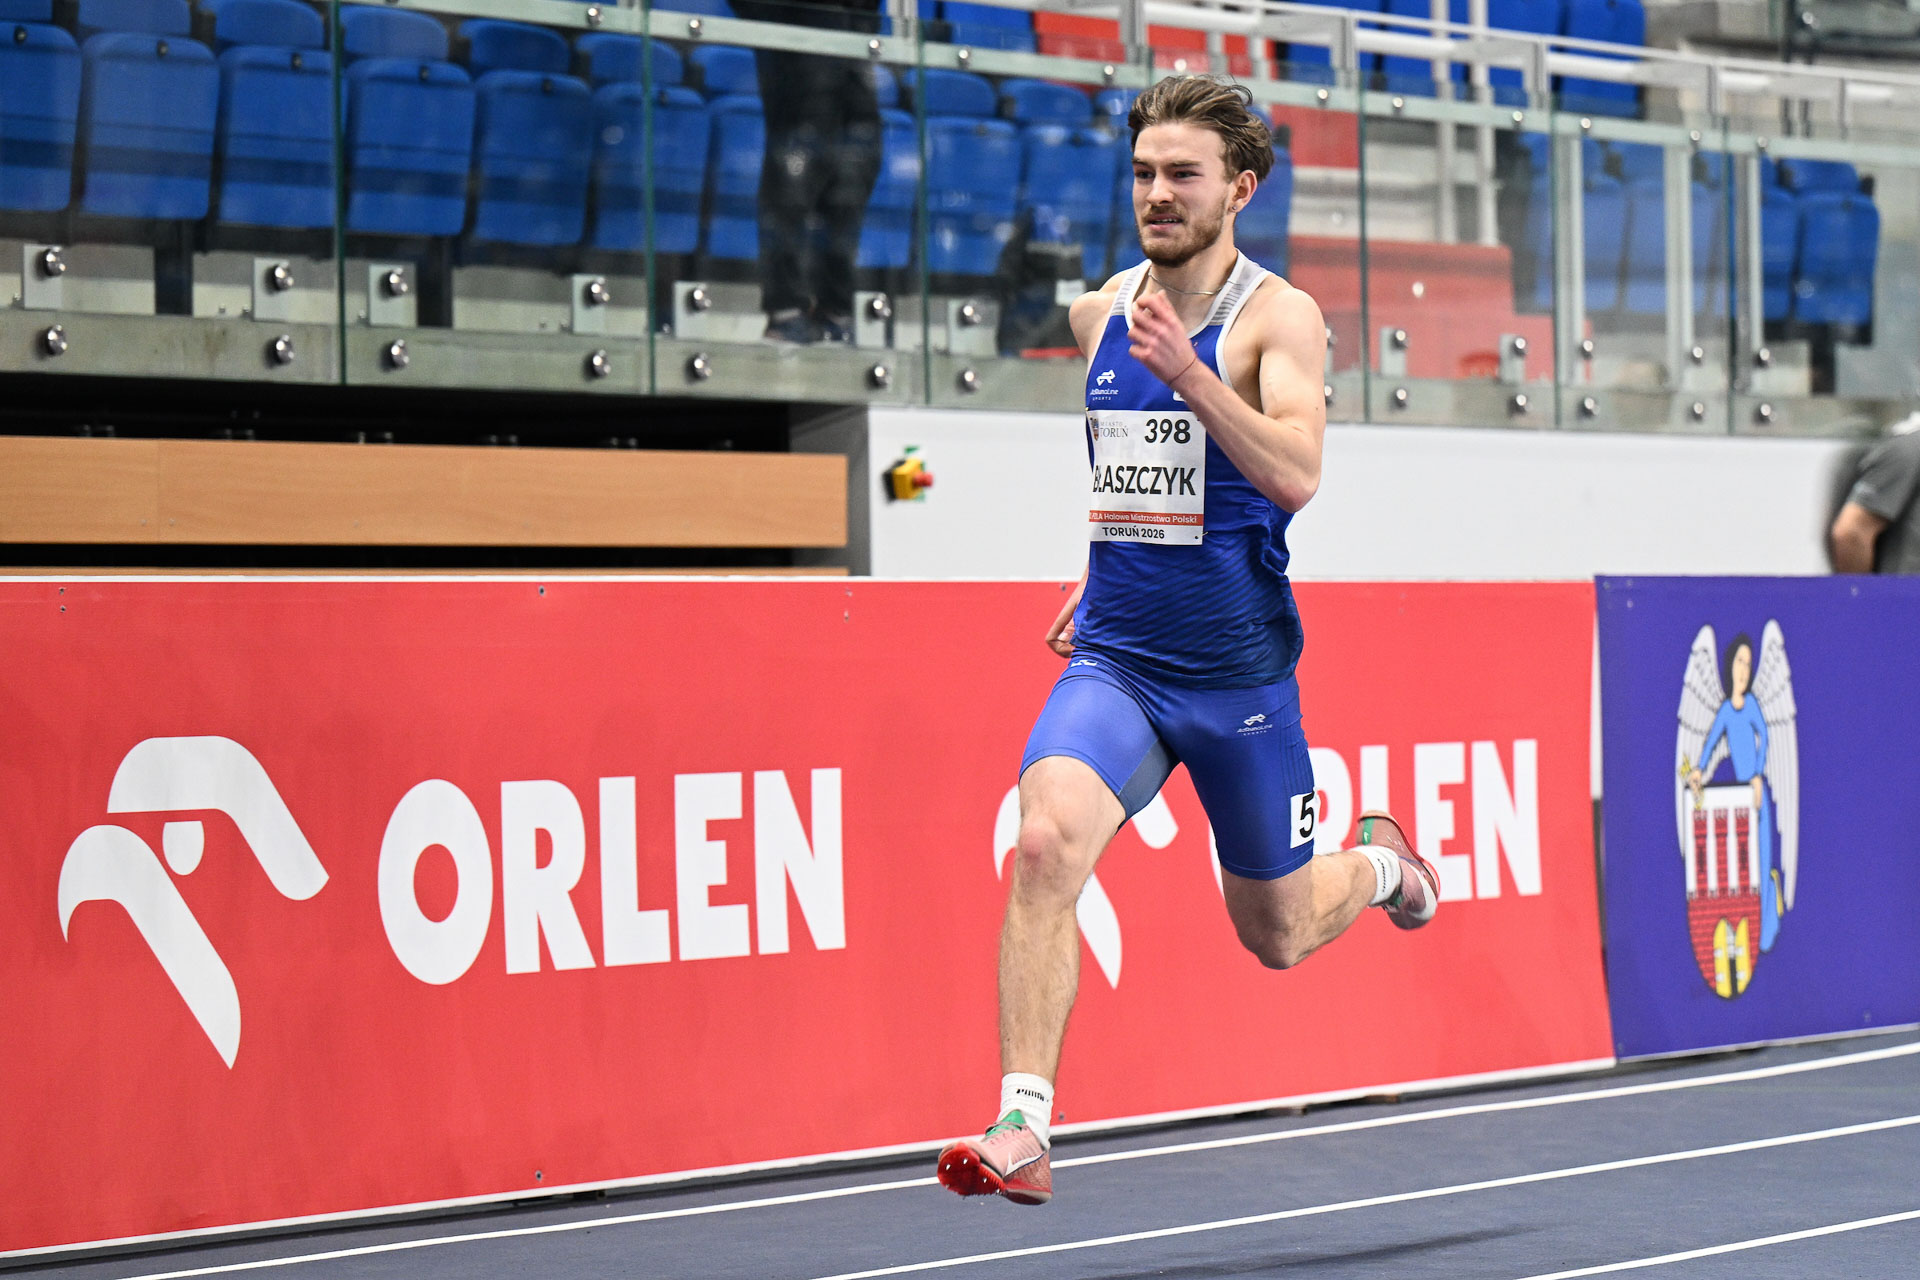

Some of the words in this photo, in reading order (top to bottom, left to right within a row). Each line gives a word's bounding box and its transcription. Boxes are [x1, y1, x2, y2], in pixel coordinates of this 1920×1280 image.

[1099, 425, 1128, 438] TORUŃ
[1144, 418, 1191, 444] 398
[1104, 512, 1130, 521] Halowe
[1130, 513, 1171, 523] Mistrzostwa
[1172, 515, 1197, 523] Polski
[1101, 525, 1139, 537] TORUŃ
[1141, 528, 1165, 539] 2026
[1208, 738, 1542, 905] REN
[1299, 789, 1315, 839] 5
[377, 767, 846, 986] ORLEN
